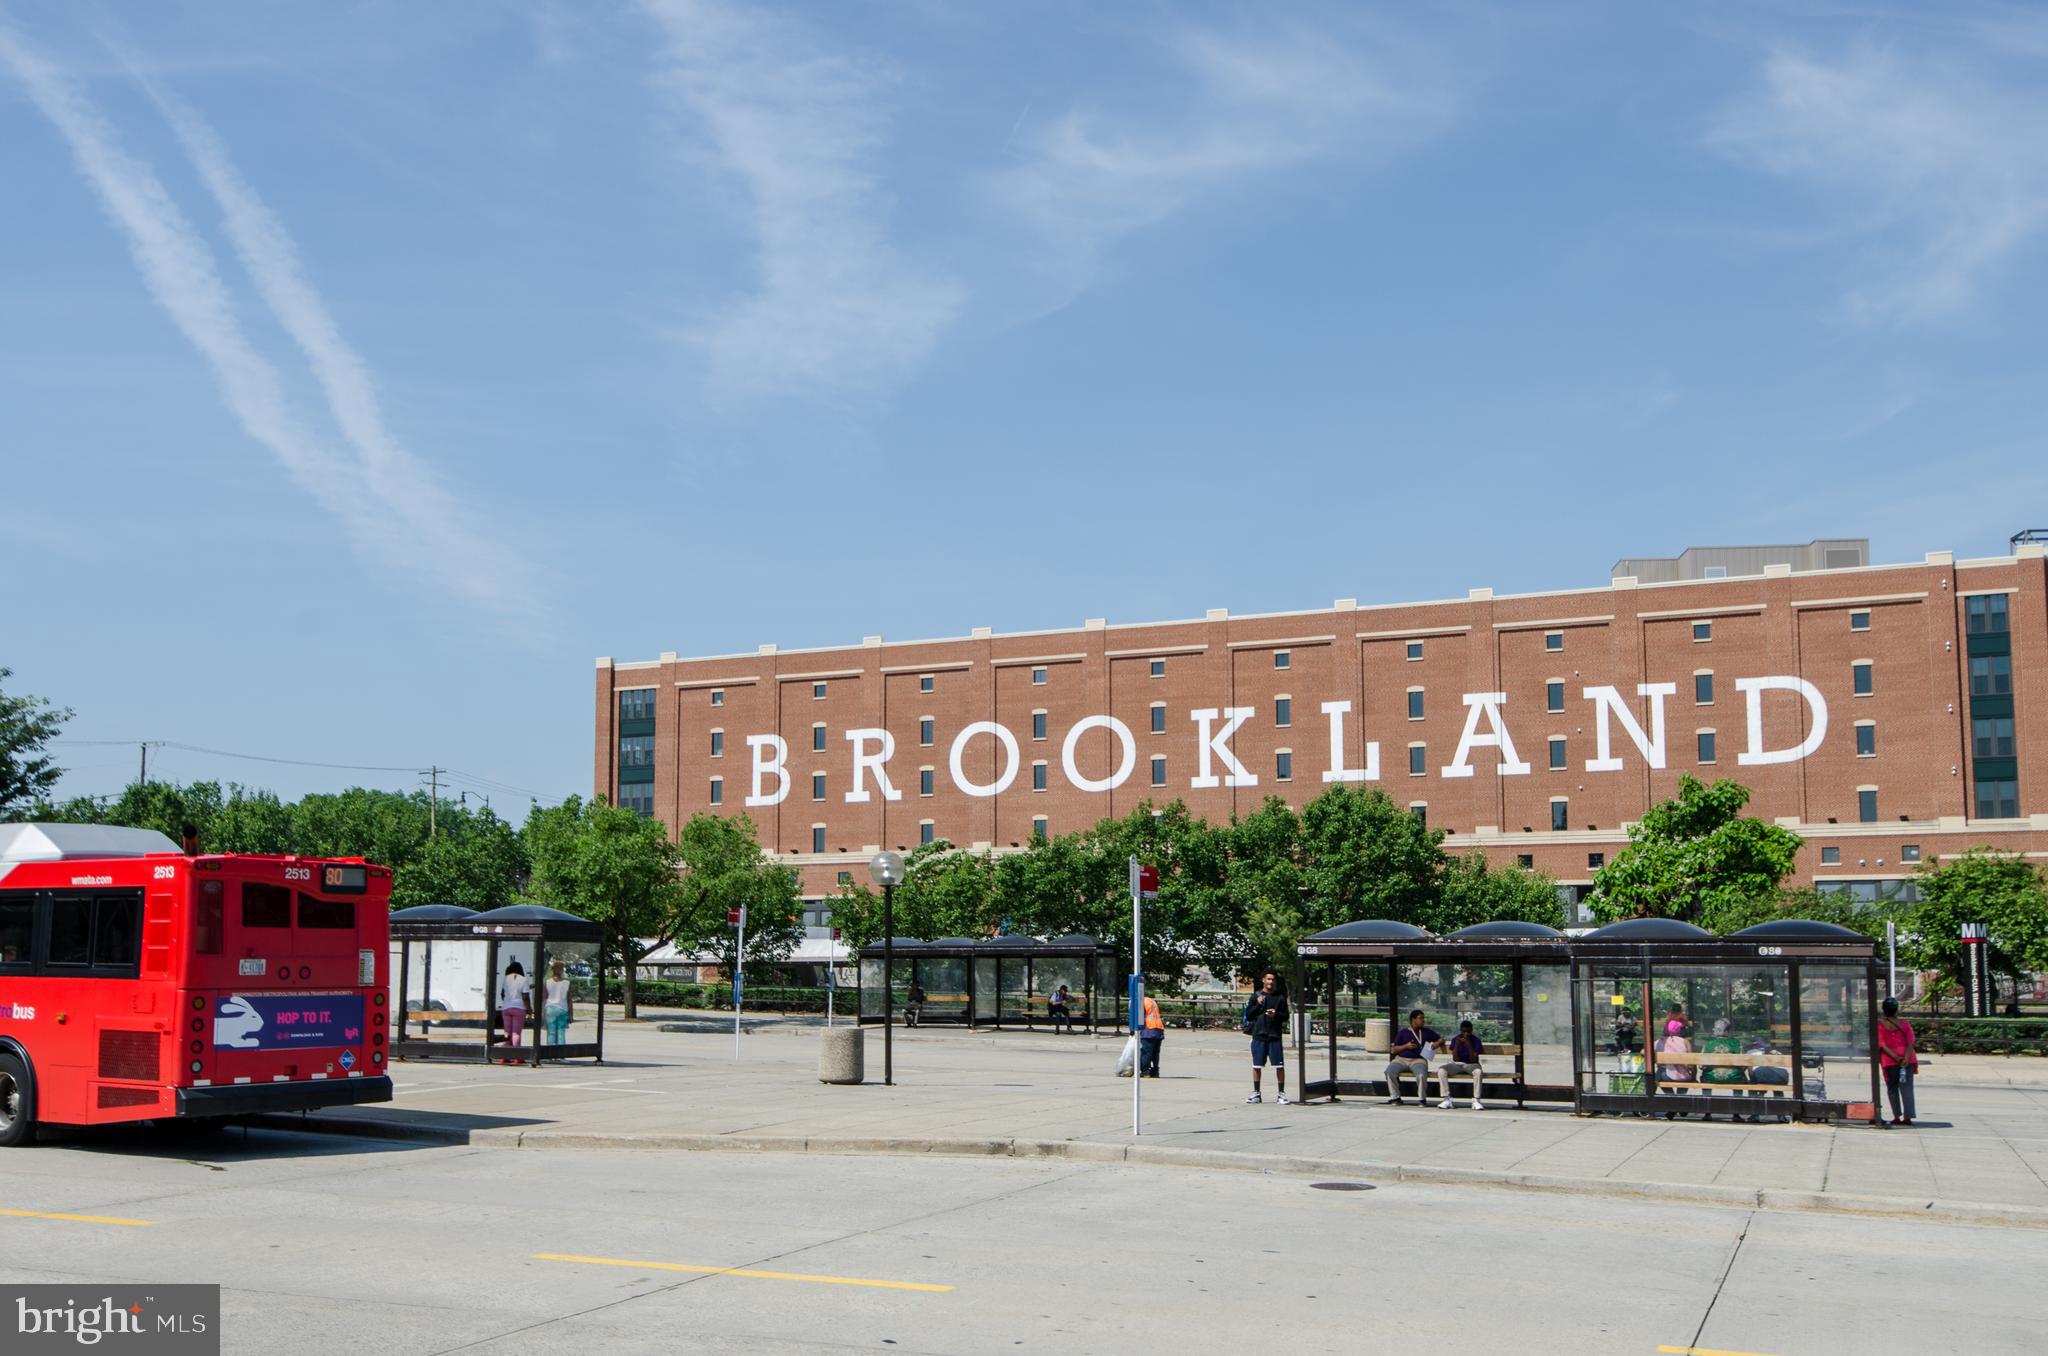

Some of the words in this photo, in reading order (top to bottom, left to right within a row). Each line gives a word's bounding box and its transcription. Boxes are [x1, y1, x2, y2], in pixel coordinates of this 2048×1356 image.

[745, 675, 1828, 807] BROOKLAND
[71, 874, 113, 885] wmata.com
[153, 866, 175, 879] 2513
[284, 867, 310, 880] 2513
[325, 867, 343, 885] 80
[1961, 923, 1977, 938] M
[0, 1002, 35, 1020] robus
[276, 1011, 300, 1025] HOP
[303, 1011, 317, 1024] TO
[319, 1010, 332, 1023] IT.
